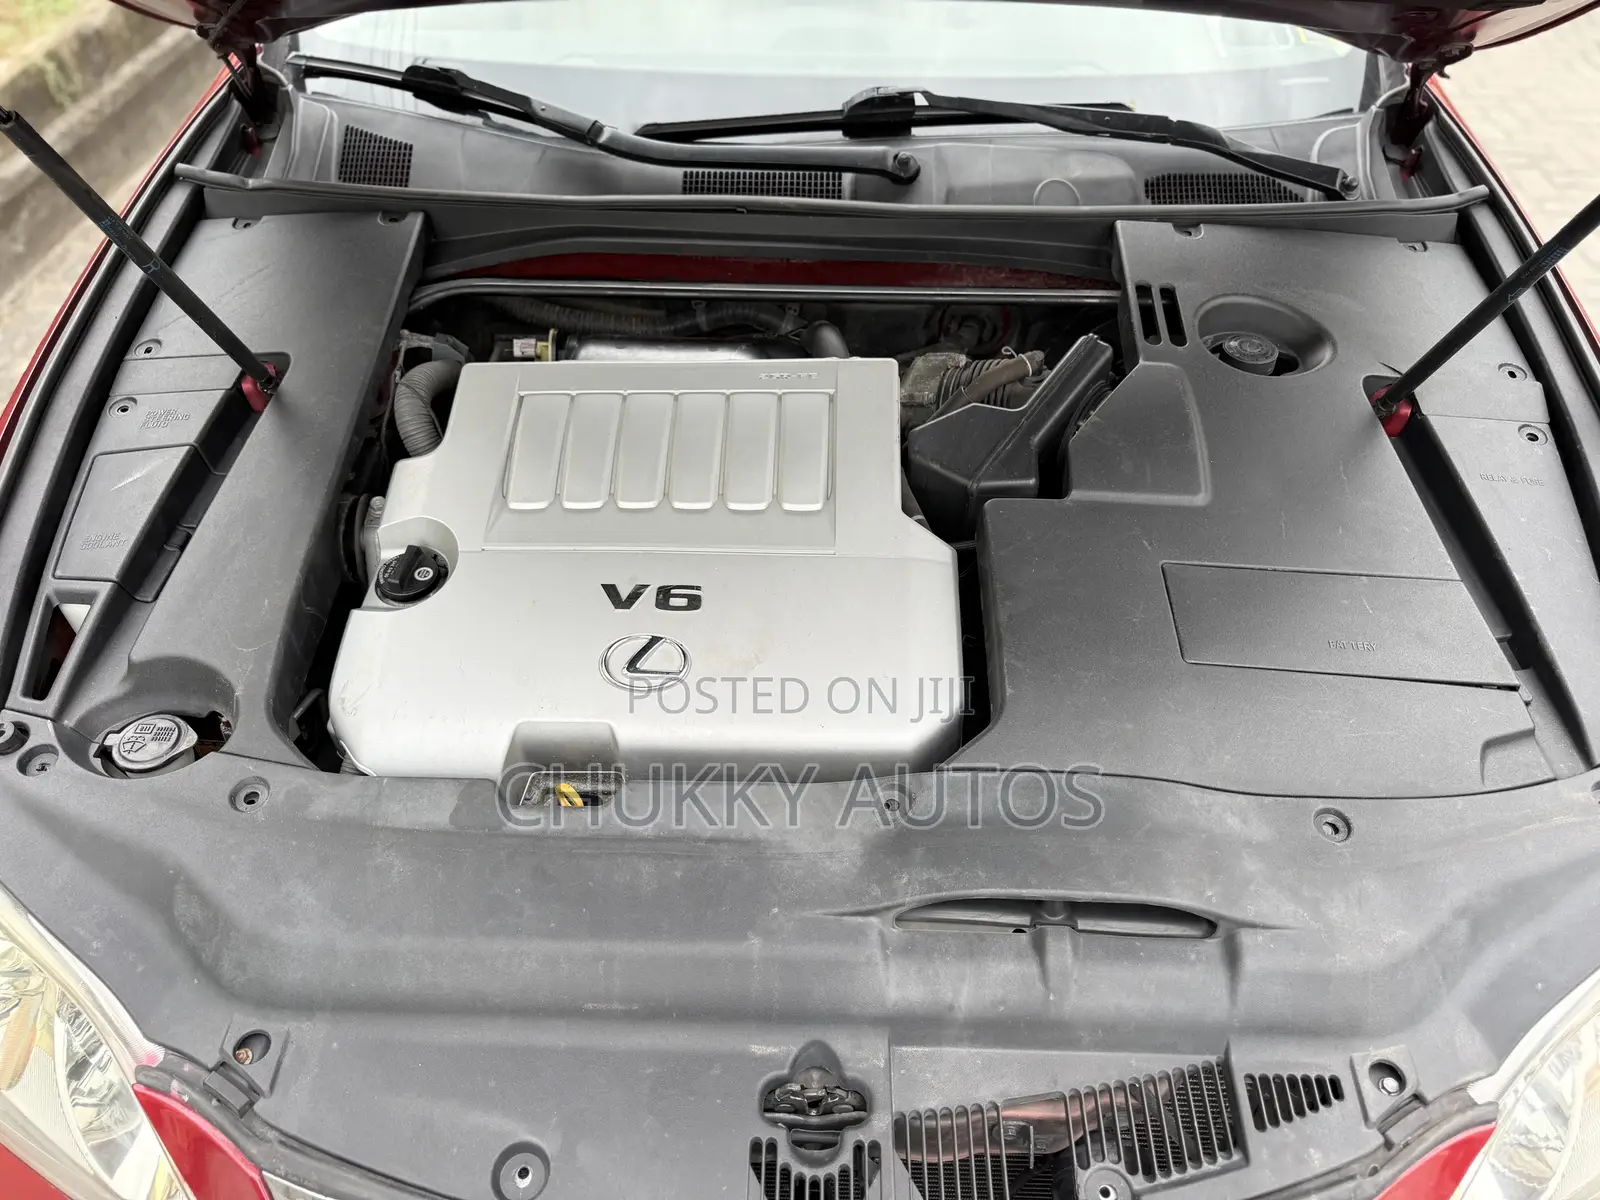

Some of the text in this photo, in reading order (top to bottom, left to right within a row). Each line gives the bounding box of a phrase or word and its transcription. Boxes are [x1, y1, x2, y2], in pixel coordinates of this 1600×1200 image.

[145, 408, 178, 417] POWER
[145, 413, 191, 422] STEERING
[139, 420, 170, 430] FLUID
[1479, 473, 1508, 483] RELAY
[1520, 476, 1545, 487] FUSE
[83, 532, 121, 543] ENGINE
[80, 539, 128, 551] COOLANT
[600, 583, 702, 612] V6
[1327, 639, 1377, 652] BATTERY
